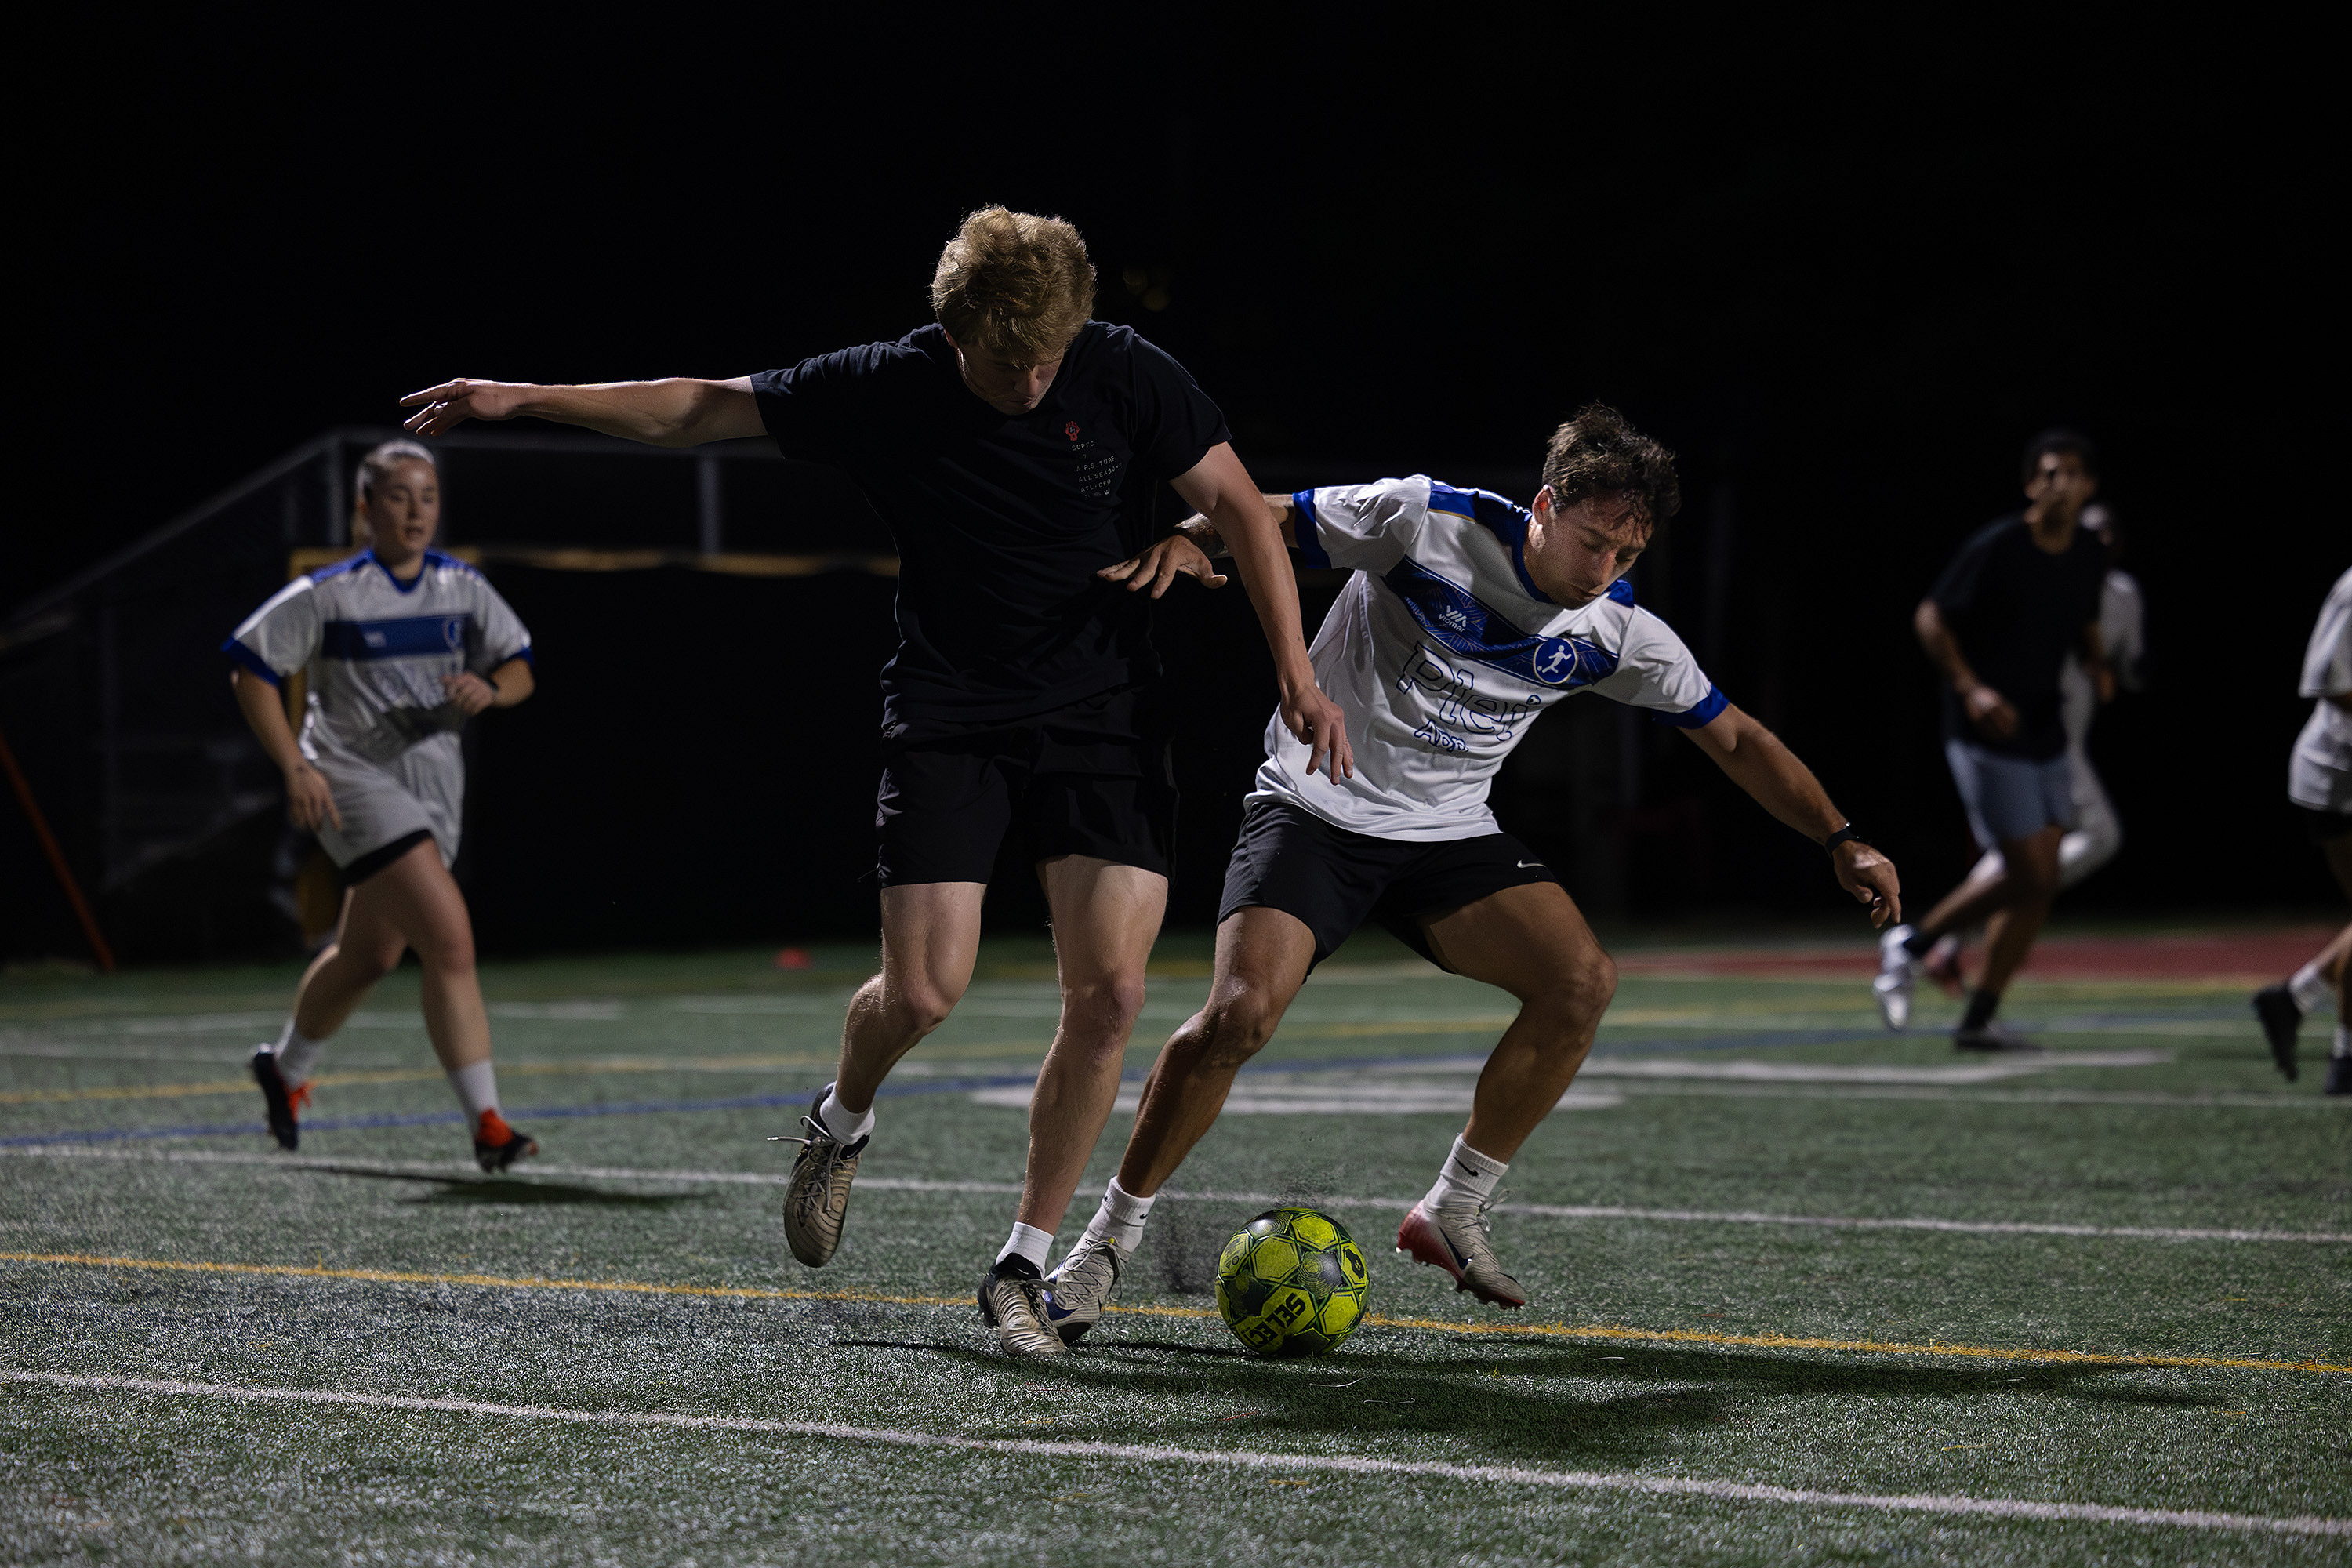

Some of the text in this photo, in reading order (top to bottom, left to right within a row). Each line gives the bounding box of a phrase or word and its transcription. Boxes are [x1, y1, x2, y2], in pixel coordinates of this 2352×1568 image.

[1099, 456, 1115, 466] TURF
[1078, 462, 1123, 483] ALL SEASONS
[1439, 613, 1466, 633] viomar
